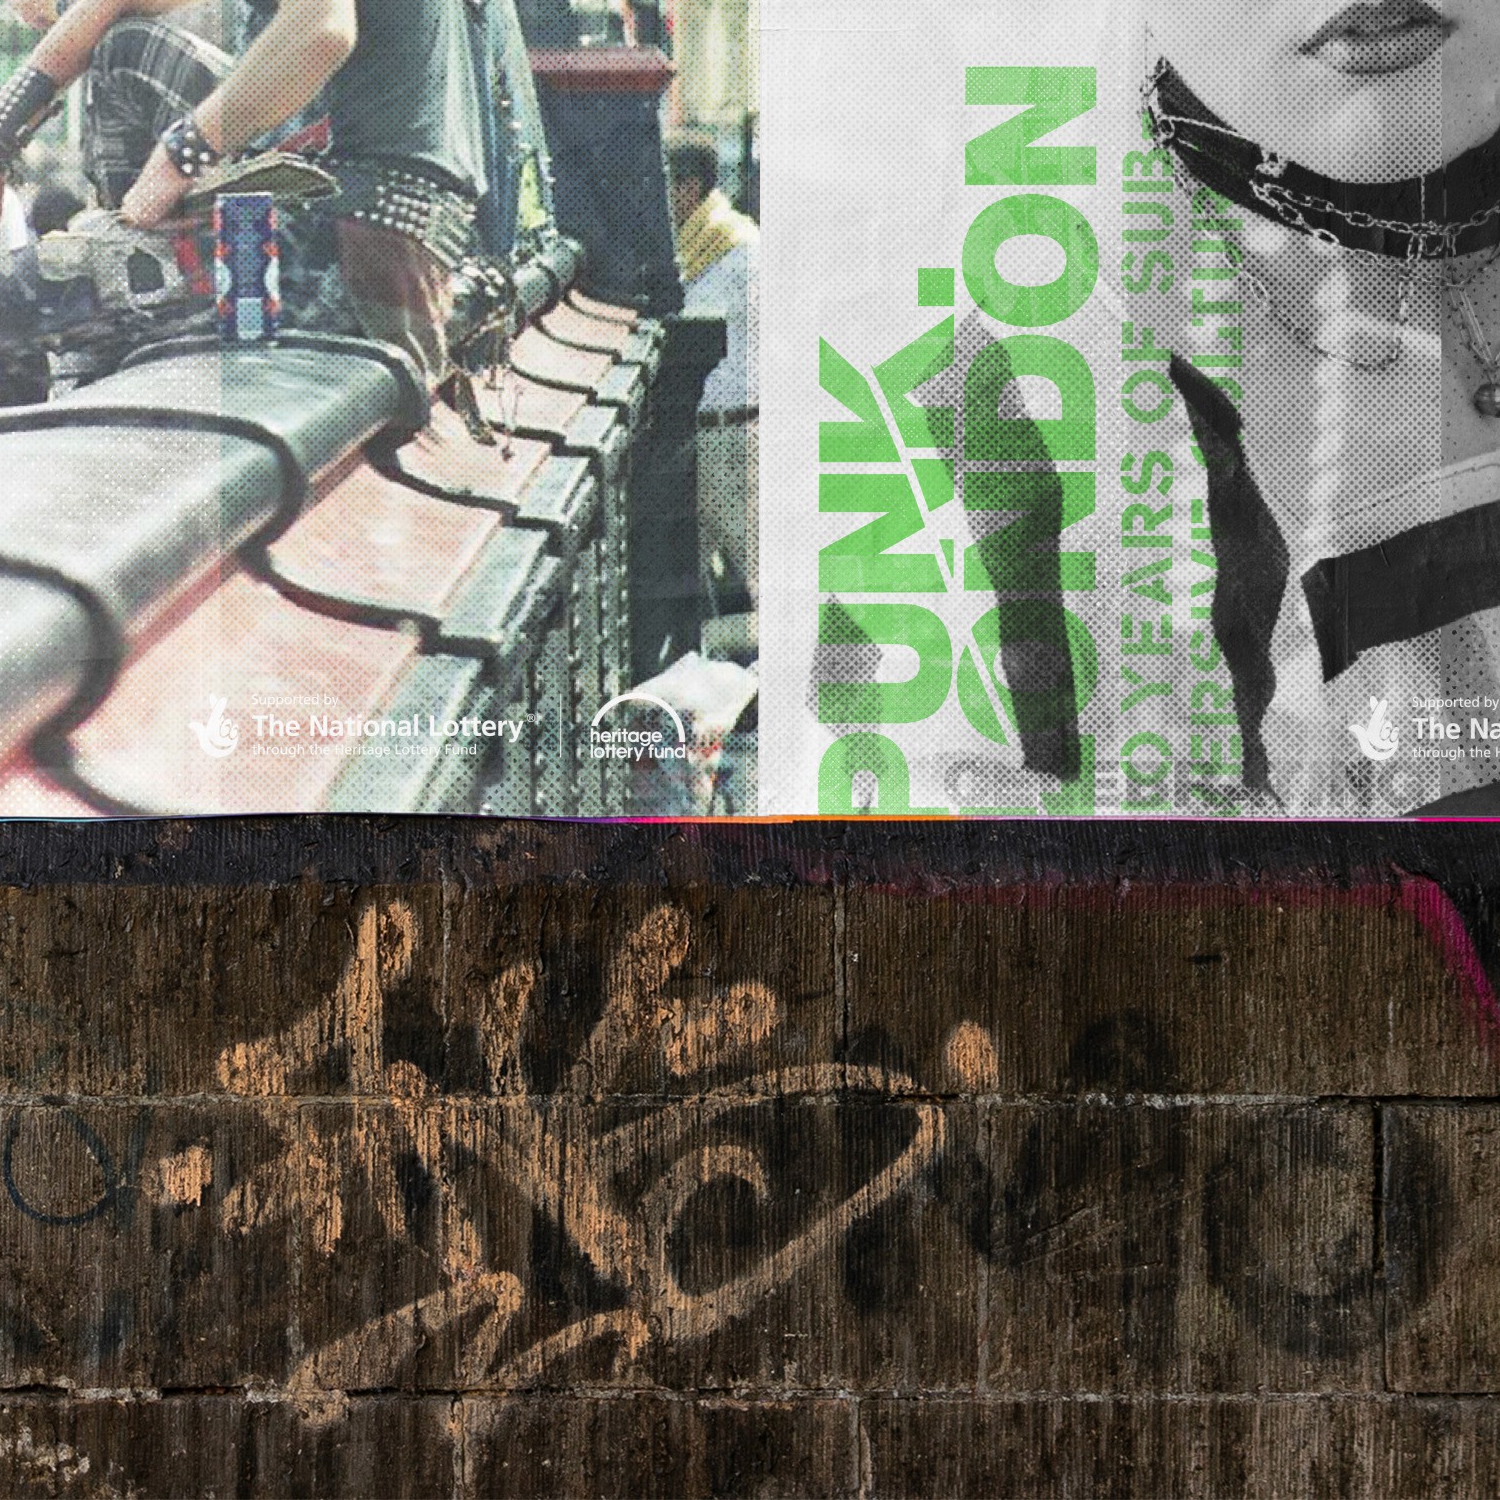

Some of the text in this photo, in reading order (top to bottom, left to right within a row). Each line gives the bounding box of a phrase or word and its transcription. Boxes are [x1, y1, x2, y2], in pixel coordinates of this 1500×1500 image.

[1120, 321, 1175, 424] OF
[1120, 450, 1175, 714] YEARS
[251, 693, 339, 708] Supported by
[1411, 695, 1500, 711] Supported by
[252, 714, 302, 738] The
[309, 714, 420, 738] National
[1412, 716, 1461, 740] The
[590, 728, 663, 747] heritage
[252, 743, 477, 758] through the Heritage Lottery Fund
[590, 744, 686, 761] lottery fund
[1412, 745, 1465, 761] through
[1468, 745, 1490, 759] the
